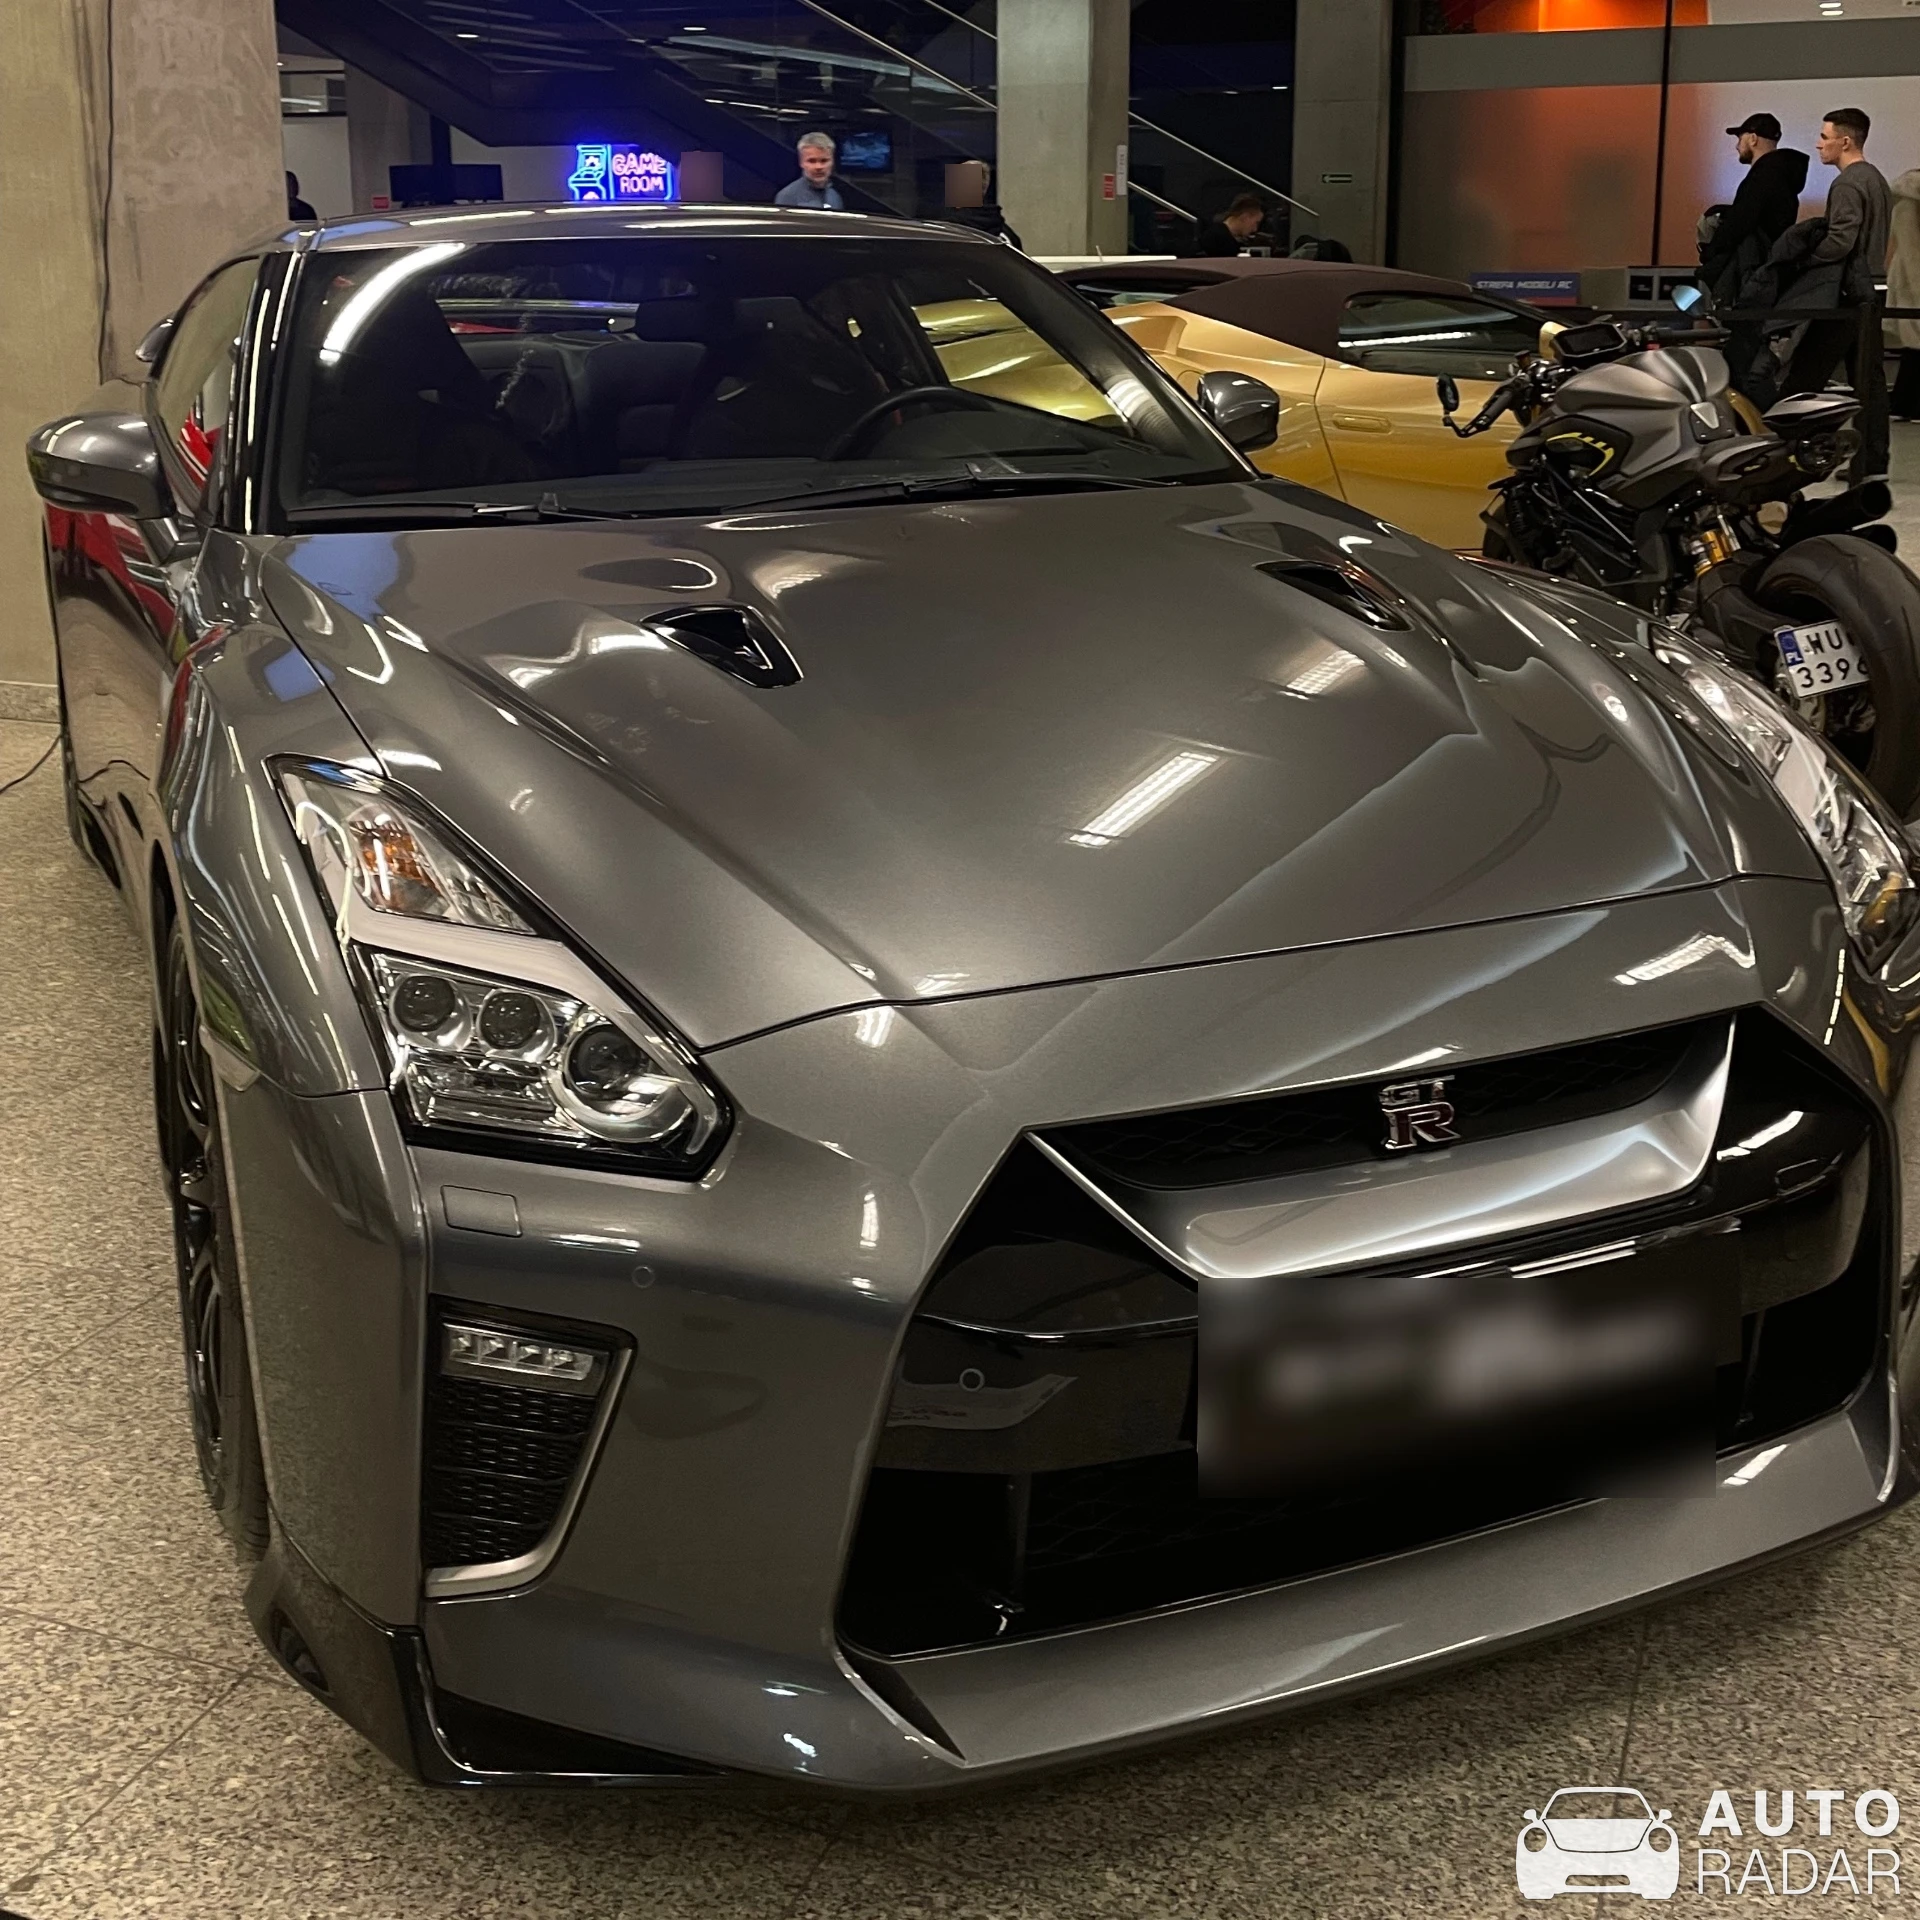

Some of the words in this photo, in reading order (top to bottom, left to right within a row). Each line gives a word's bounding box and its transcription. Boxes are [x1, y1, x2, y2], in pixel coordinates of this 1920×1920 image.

[612, 152, 667, 175] GAME
[620, 176, 664, 193] ROOM
[1476, 280, 1514, 290] STREFA
[1557, 280, 1573, 290] RC
[1785, 651, 1803, 663] PL
